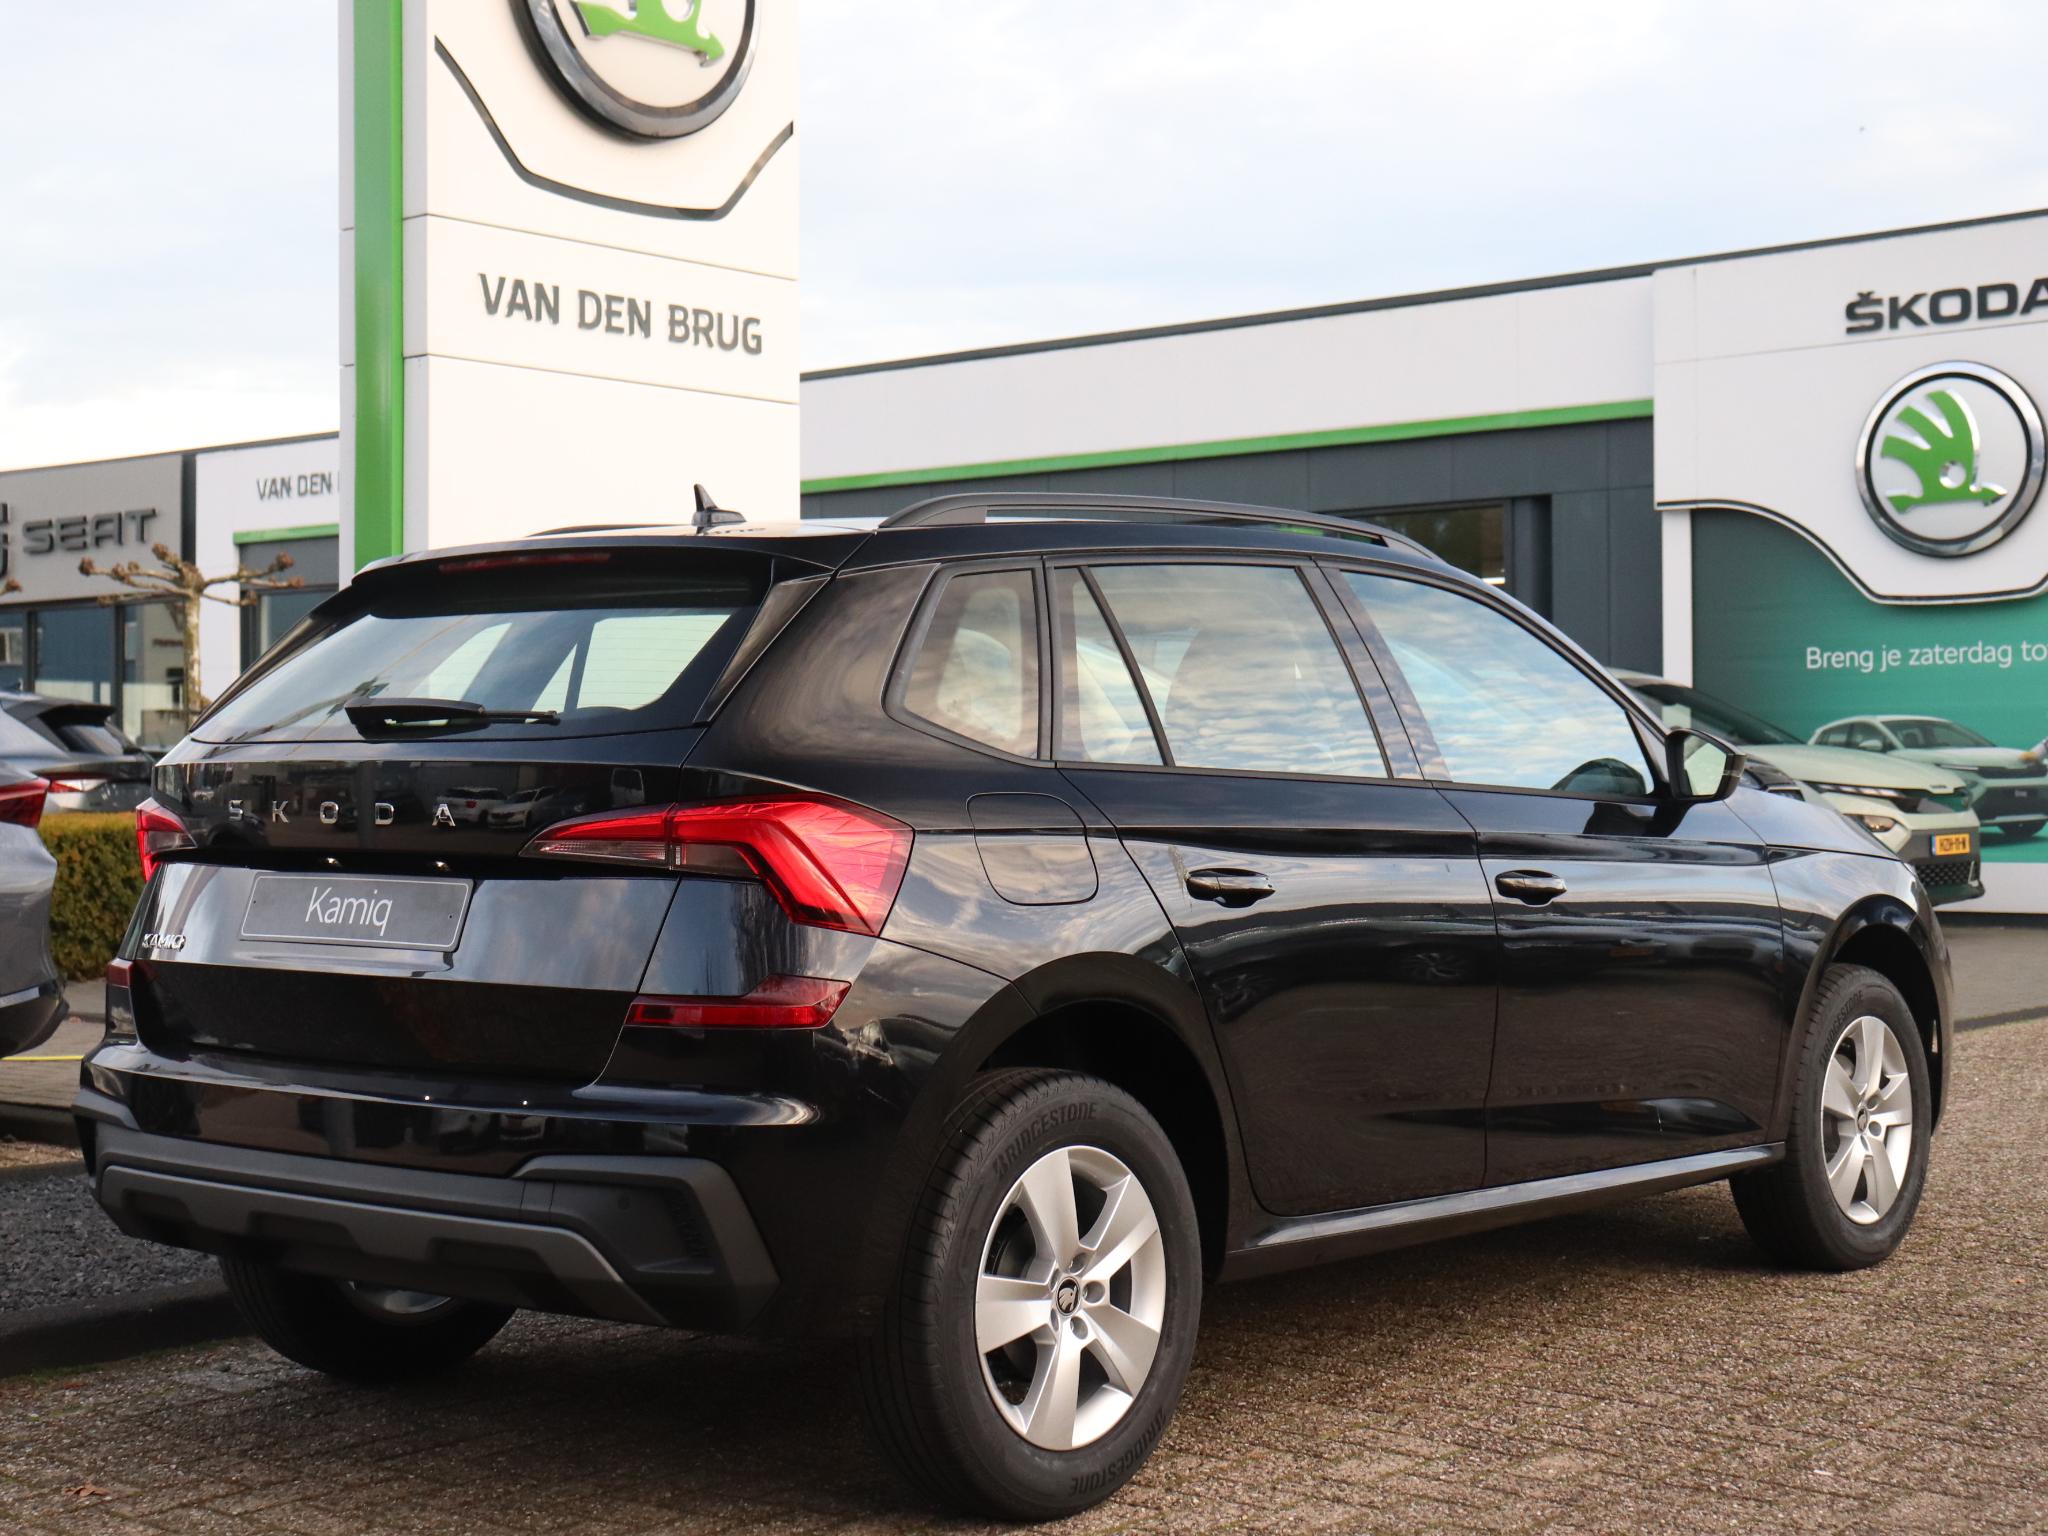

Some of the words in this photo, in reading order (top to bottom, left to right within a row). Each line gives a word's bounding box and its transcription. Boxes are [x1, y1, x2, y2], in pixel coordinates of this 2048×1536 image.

[478, 273, 559, 325] VAN
[578, 289, 650, 339] DEN
[668, 304, 762, 355] BRUG
[256, 476, 291, 501] VAN
[297, 472, 332, 497] DEN
[23, 508, 157, 555] SEAT
[1806, 647, 1874, 673] Breng
[1880, 645, 1901, 672] je
[1908, 640, 2012, 668] zaterdag
[2020, 640, 2048, 661] to
[228, 800, 456, 827] SKODA
[305, 886, 393, 937] Kamiq
[142, 933, 186, 952] KAMIQ
[992, 1102, 1098, 1177] BRIDGESTONE
